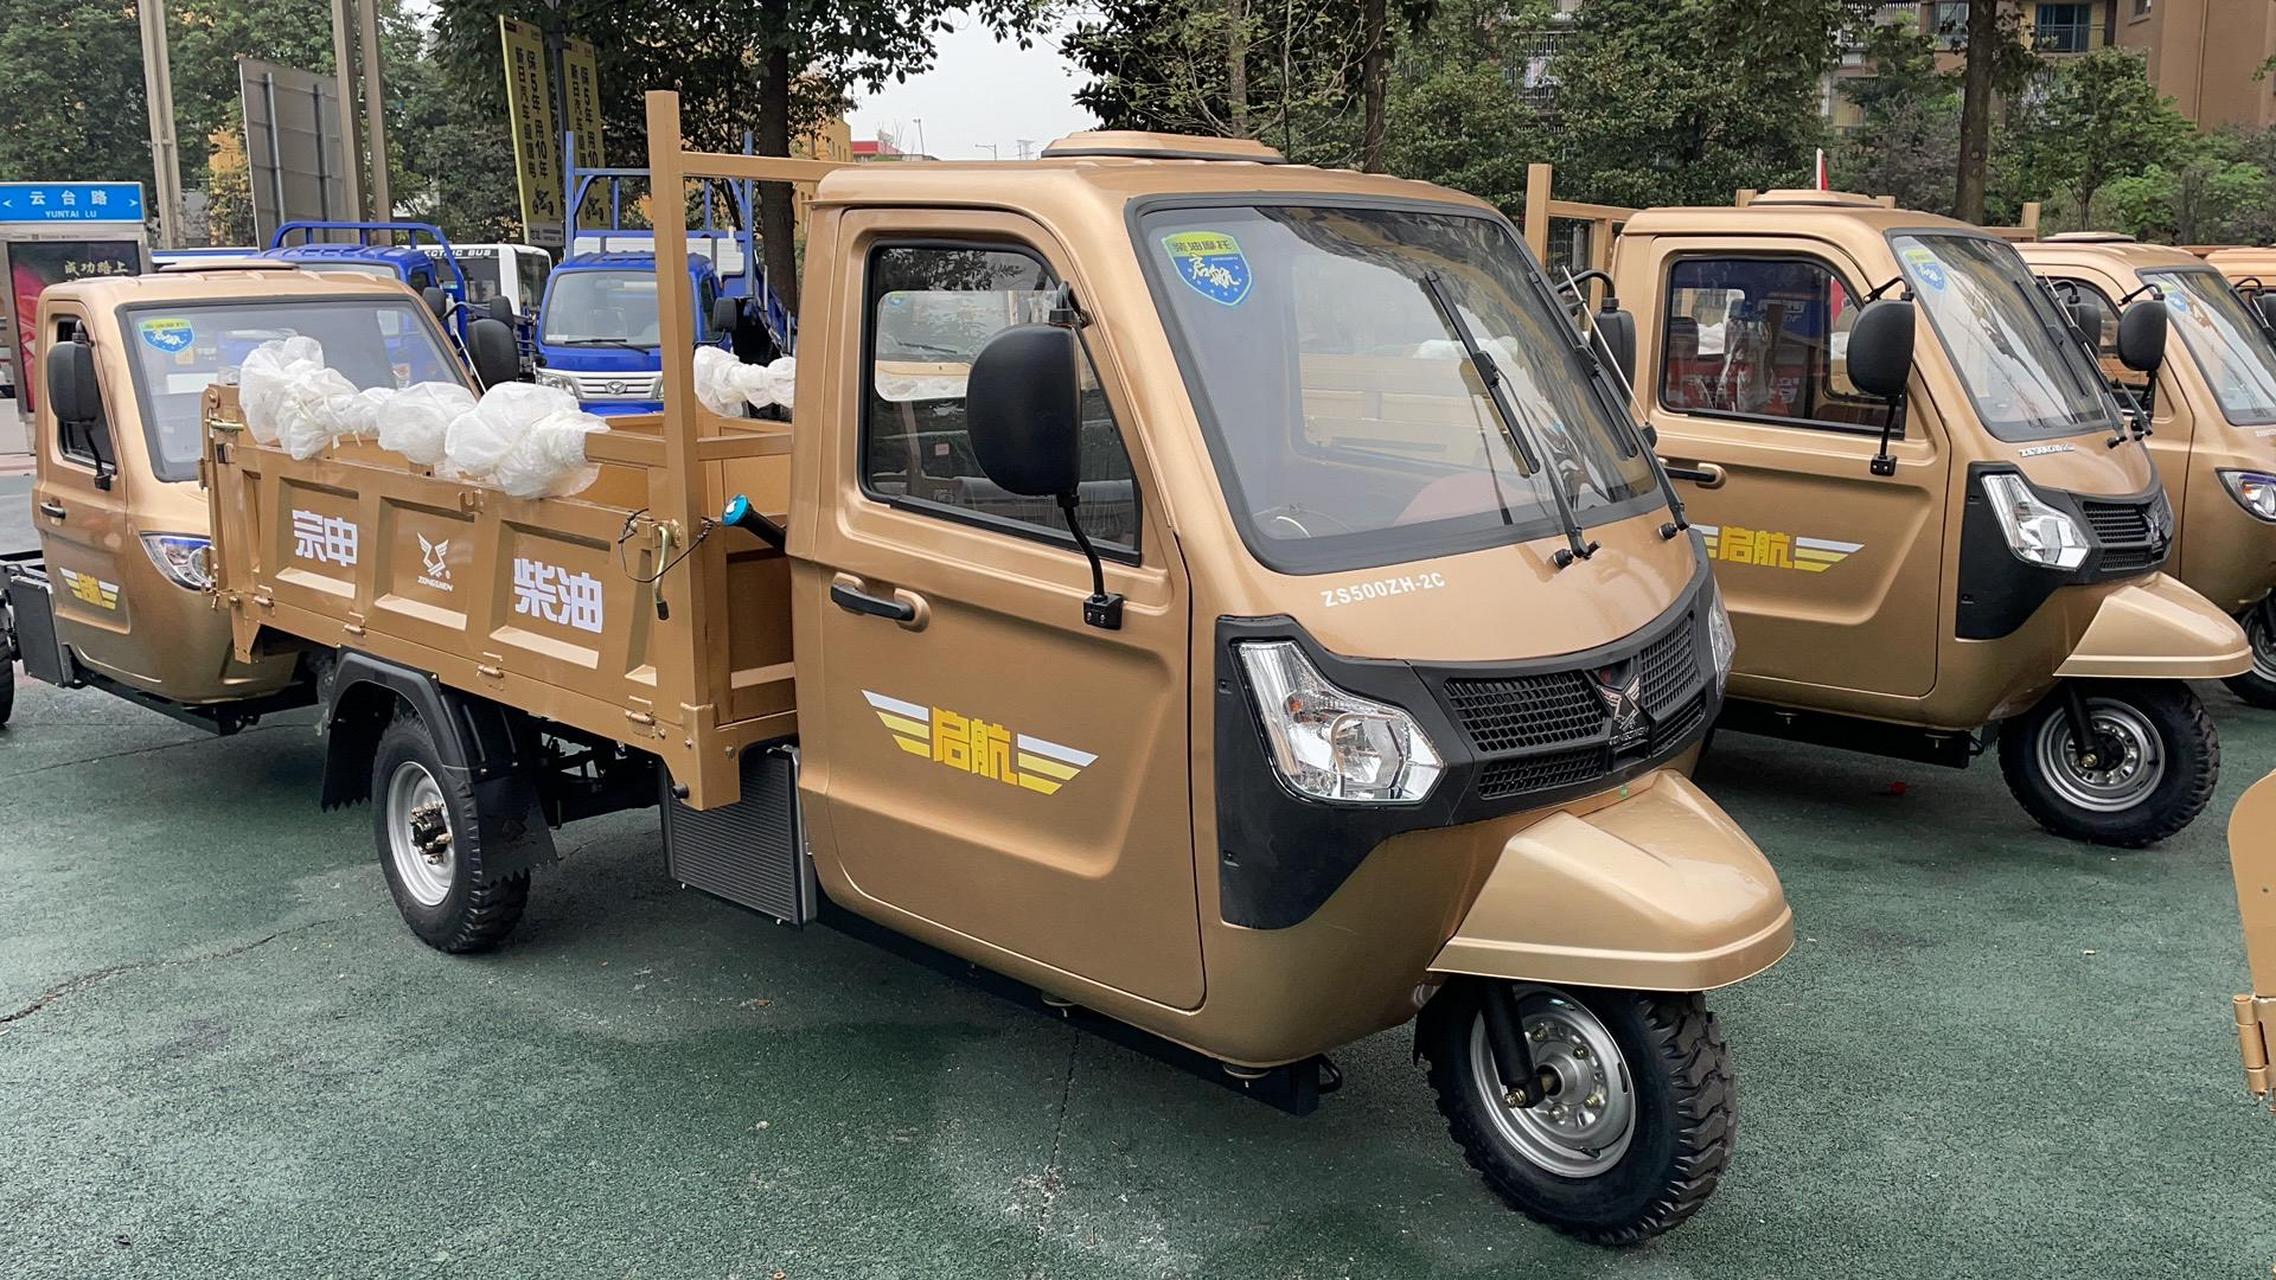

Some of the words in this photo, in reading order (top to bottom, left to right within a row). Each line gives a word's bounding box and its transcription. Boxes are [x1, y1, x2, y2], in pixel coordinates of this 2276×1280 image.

[29, 189, 107, 206] 云台路
[45, 210, 79, 218] YUNTAI
[85, 210, 97, 218] LU
[467, 249, 491, 257] BUS
[292, 509, 358, 567] 宗申
[1719, 525, 1794, 569] 启航
[513, 558, 603, 634] 柴油
[1320, 572, 1446, 608] ZS500ZH-2C
[932, 705, 1018, 786] 启航
